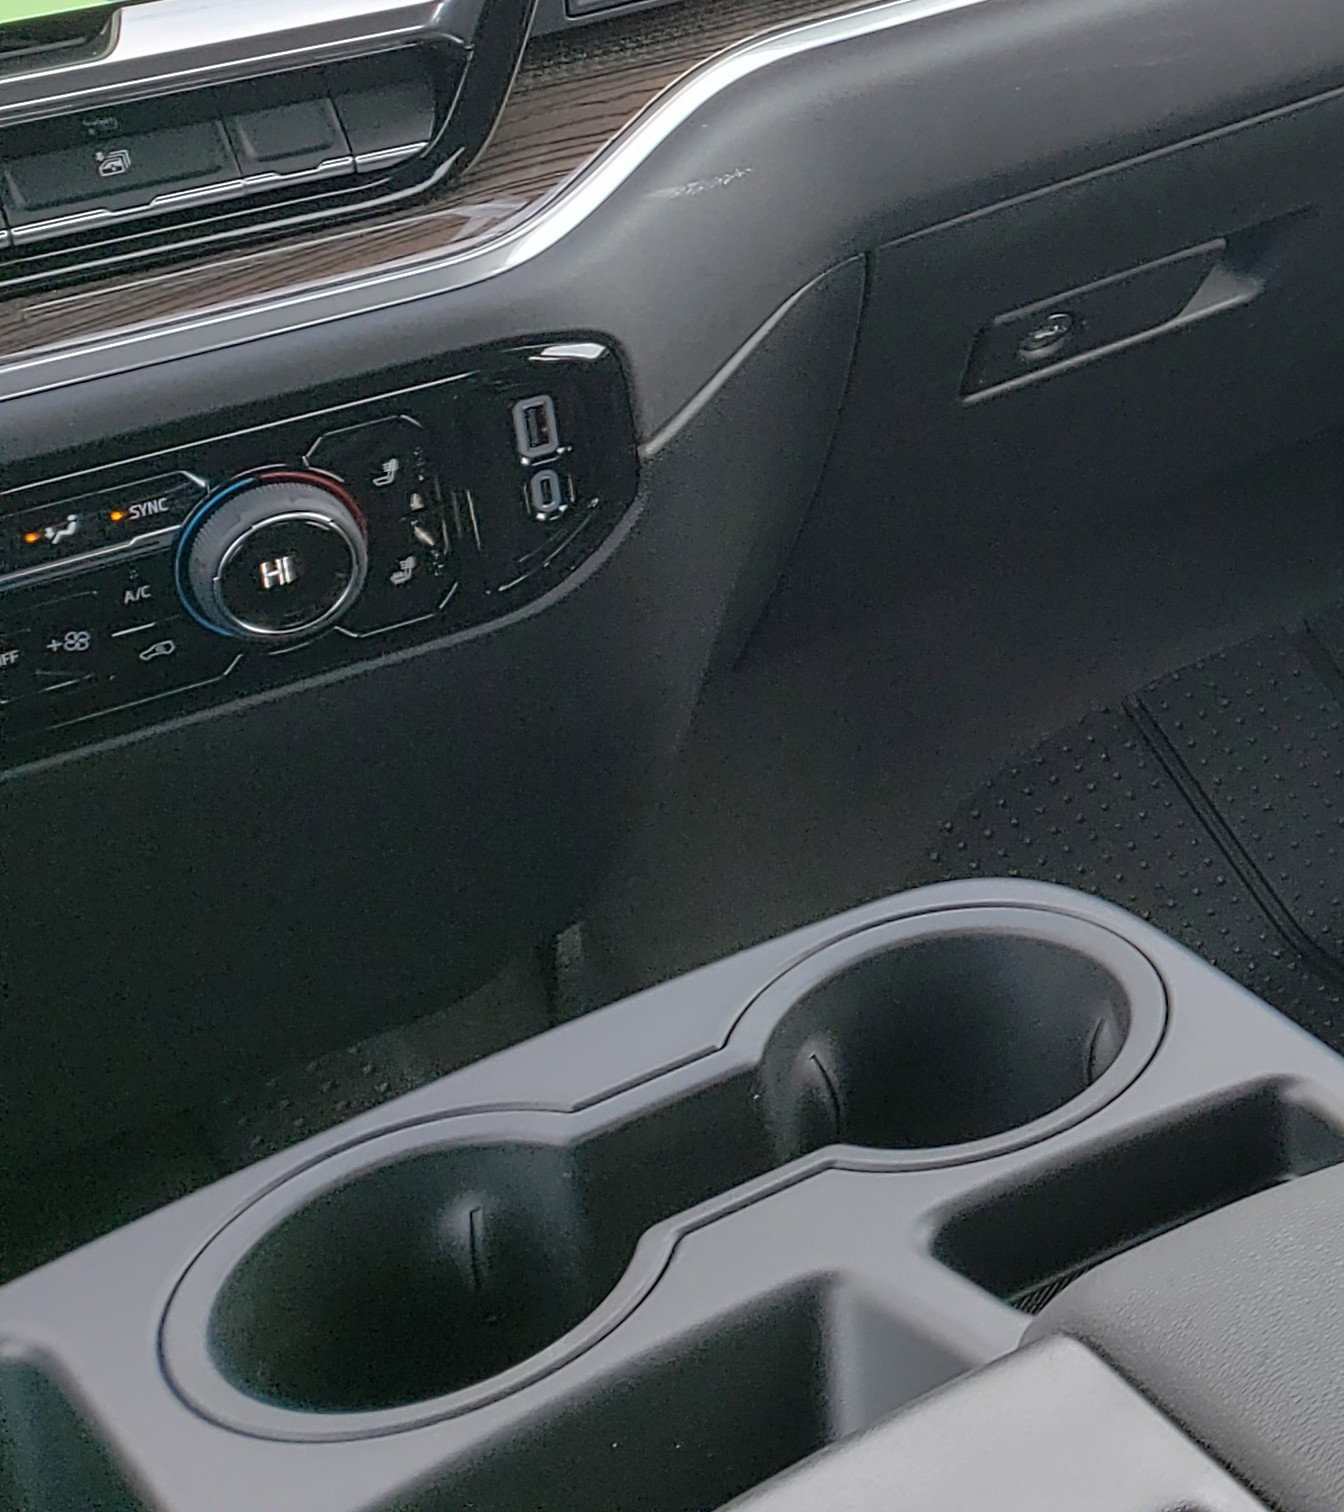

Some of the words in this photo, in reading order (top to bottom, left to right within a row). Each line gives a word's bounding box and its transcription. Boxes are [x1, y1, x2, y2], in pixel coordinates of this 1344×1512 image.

[128, 498, 169, 520] SYNC
[260, 556, 291, 589] HI
[124, 584, 151, 605] A/C
[0, 649, 19, 667] FF
